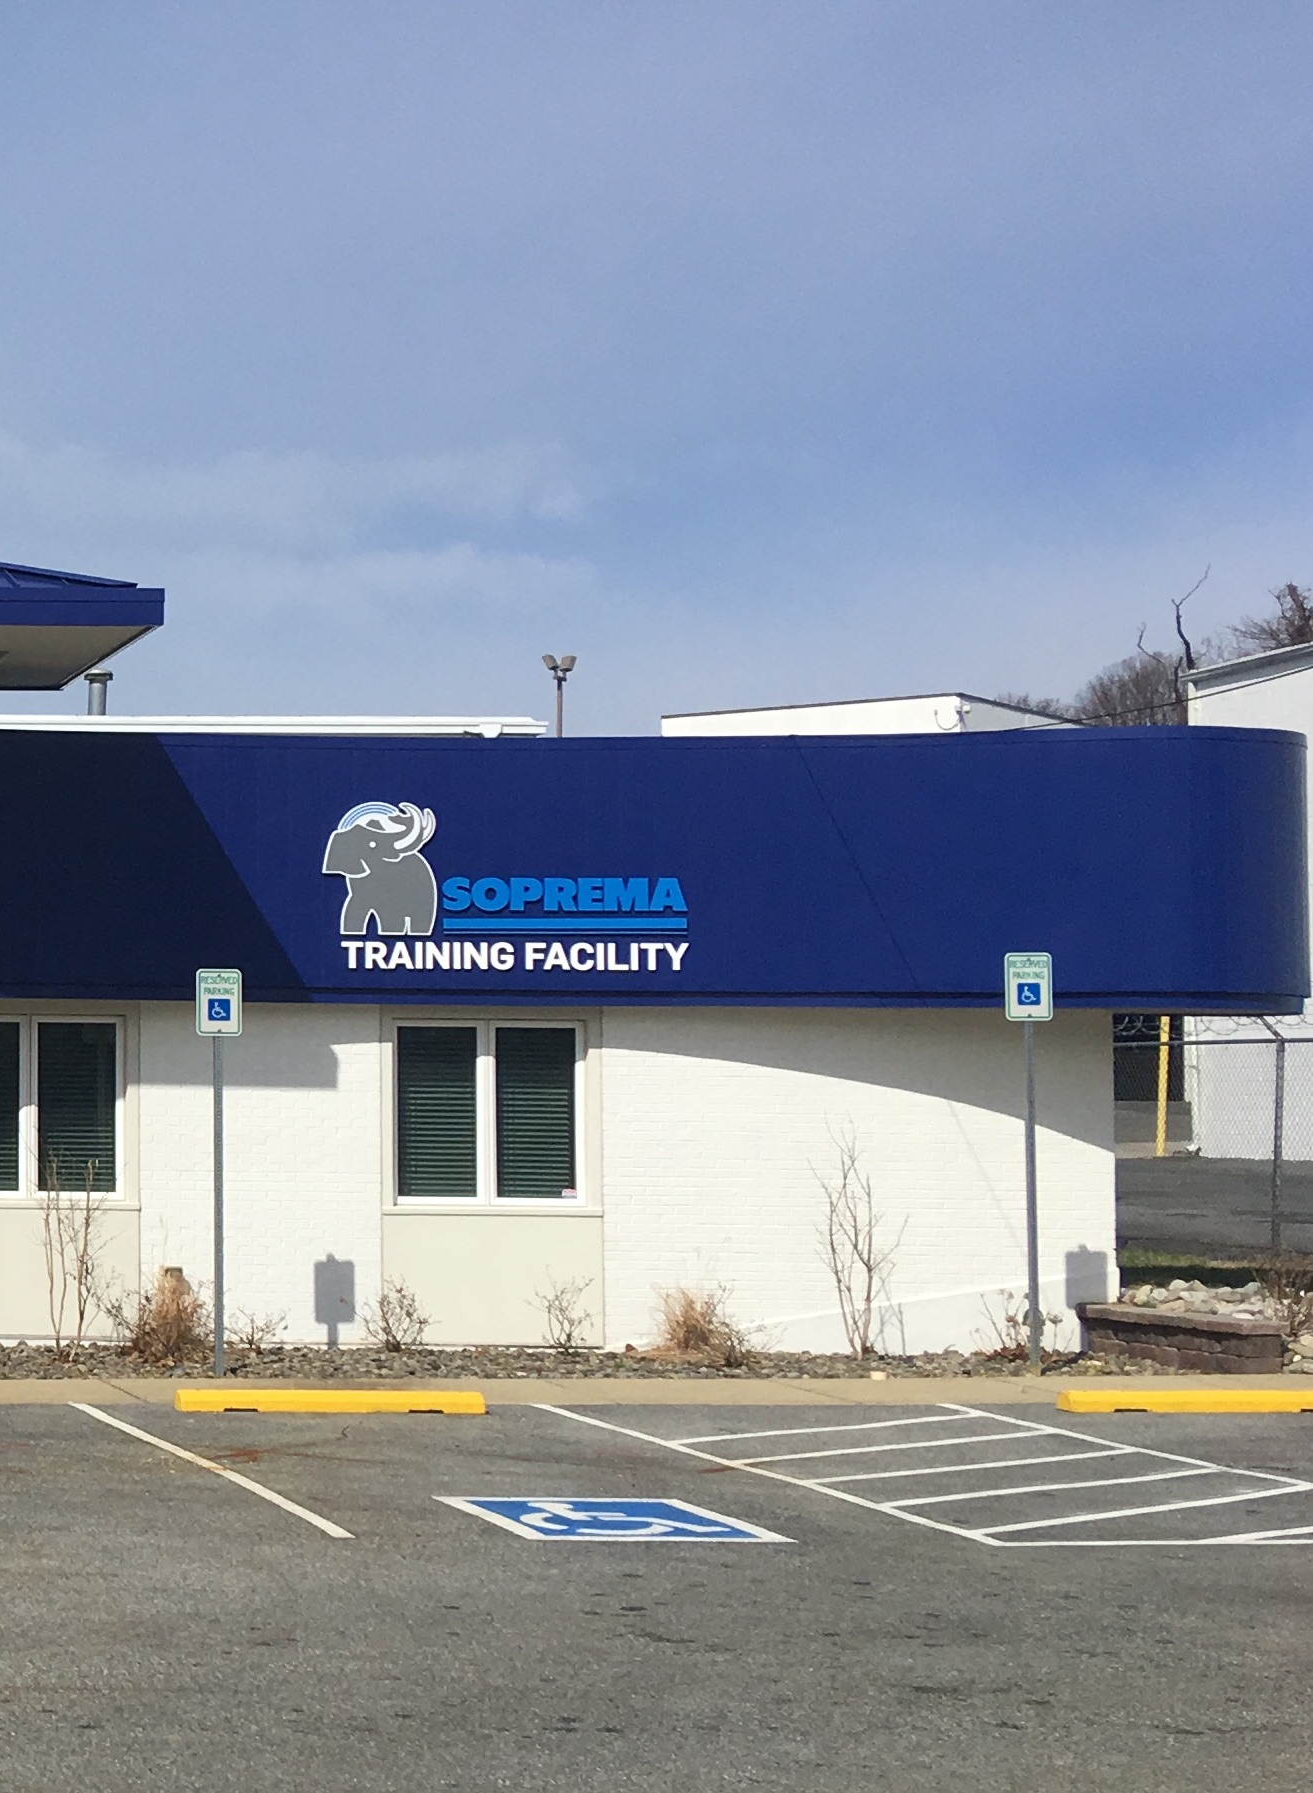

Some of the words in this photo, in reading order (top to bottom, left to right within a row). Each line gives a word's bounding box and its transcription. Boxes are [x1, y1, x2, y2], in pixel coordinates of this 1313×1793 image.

[442, 877, 687, 911] SOPREMA
[341, 941, 515, 971] TRAINING
[525, 942, 689, 971] FACILITY
[203, 987, 235, 995] PARKING
